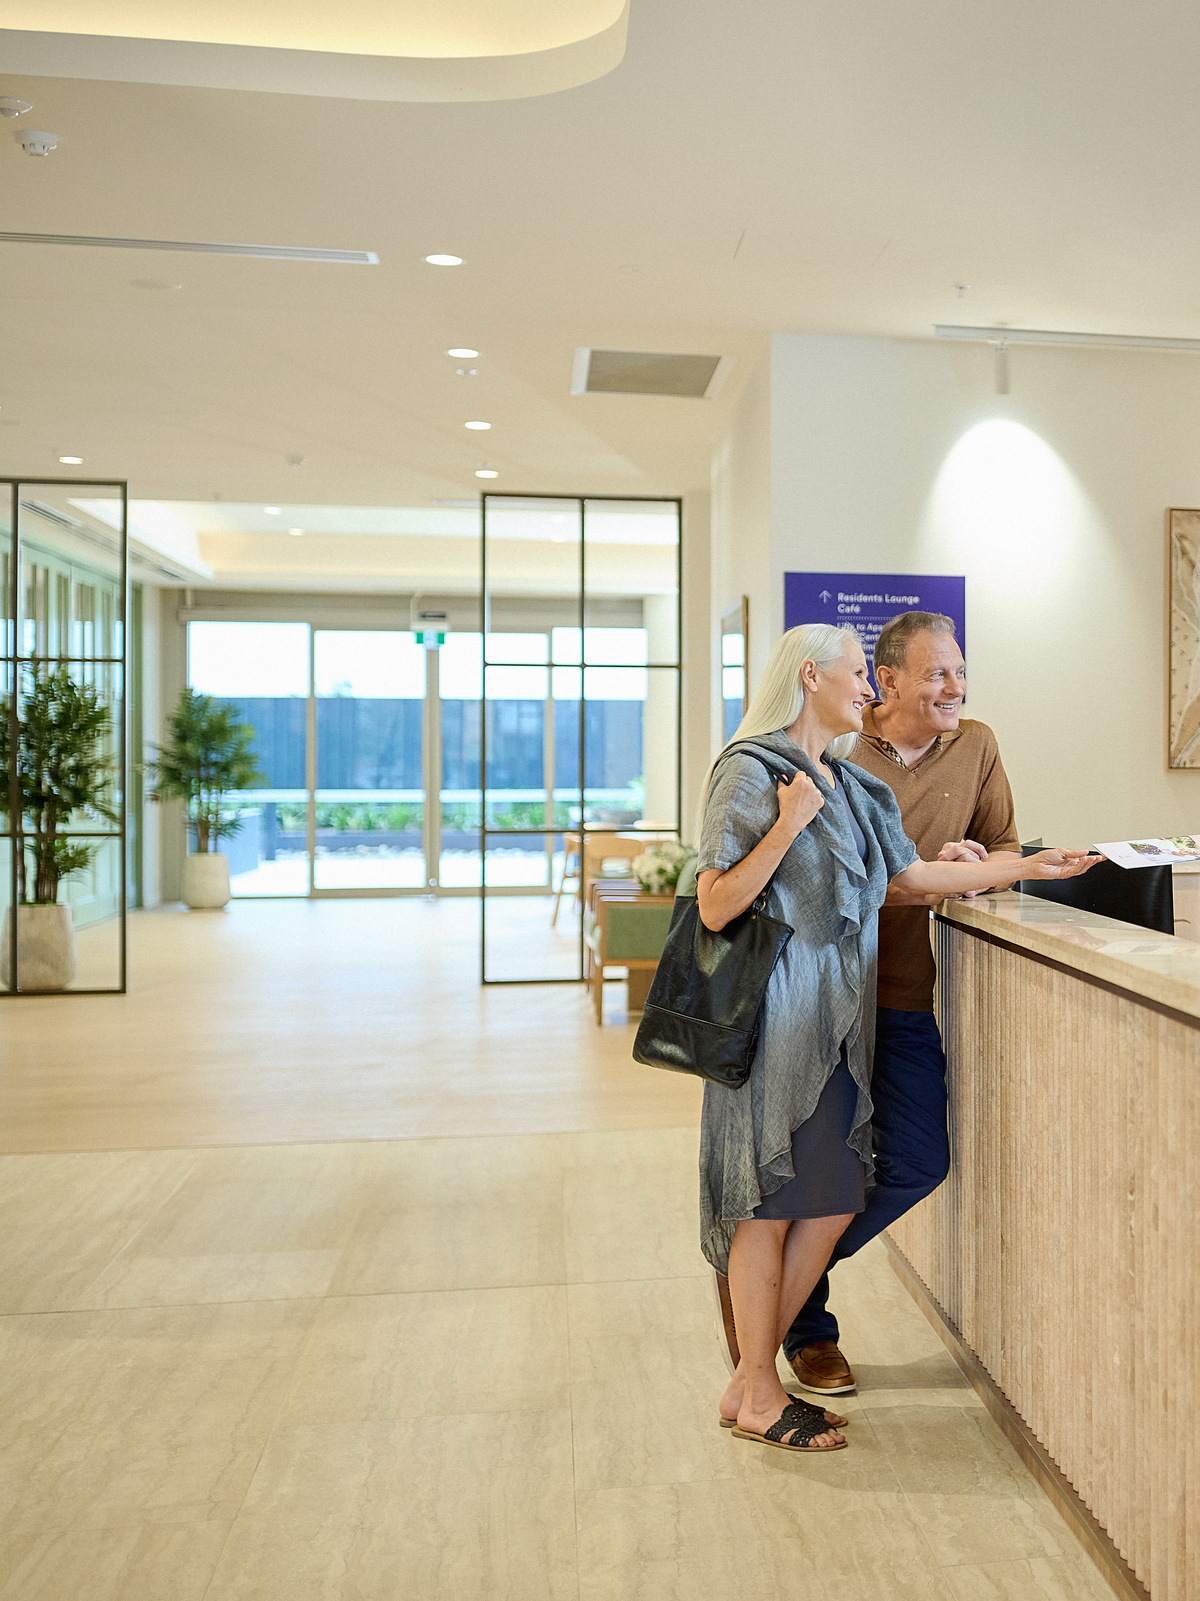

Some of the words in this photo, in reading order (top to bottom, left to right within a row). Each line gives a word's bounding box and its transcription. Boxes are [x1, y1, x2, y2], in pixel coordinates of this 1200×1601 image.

[837, 592, 883, 603] Residents
[884, 593, 920, 606] Lounge
[837, 603, 861, 614] Café
[856, 622, 867, 632] to
